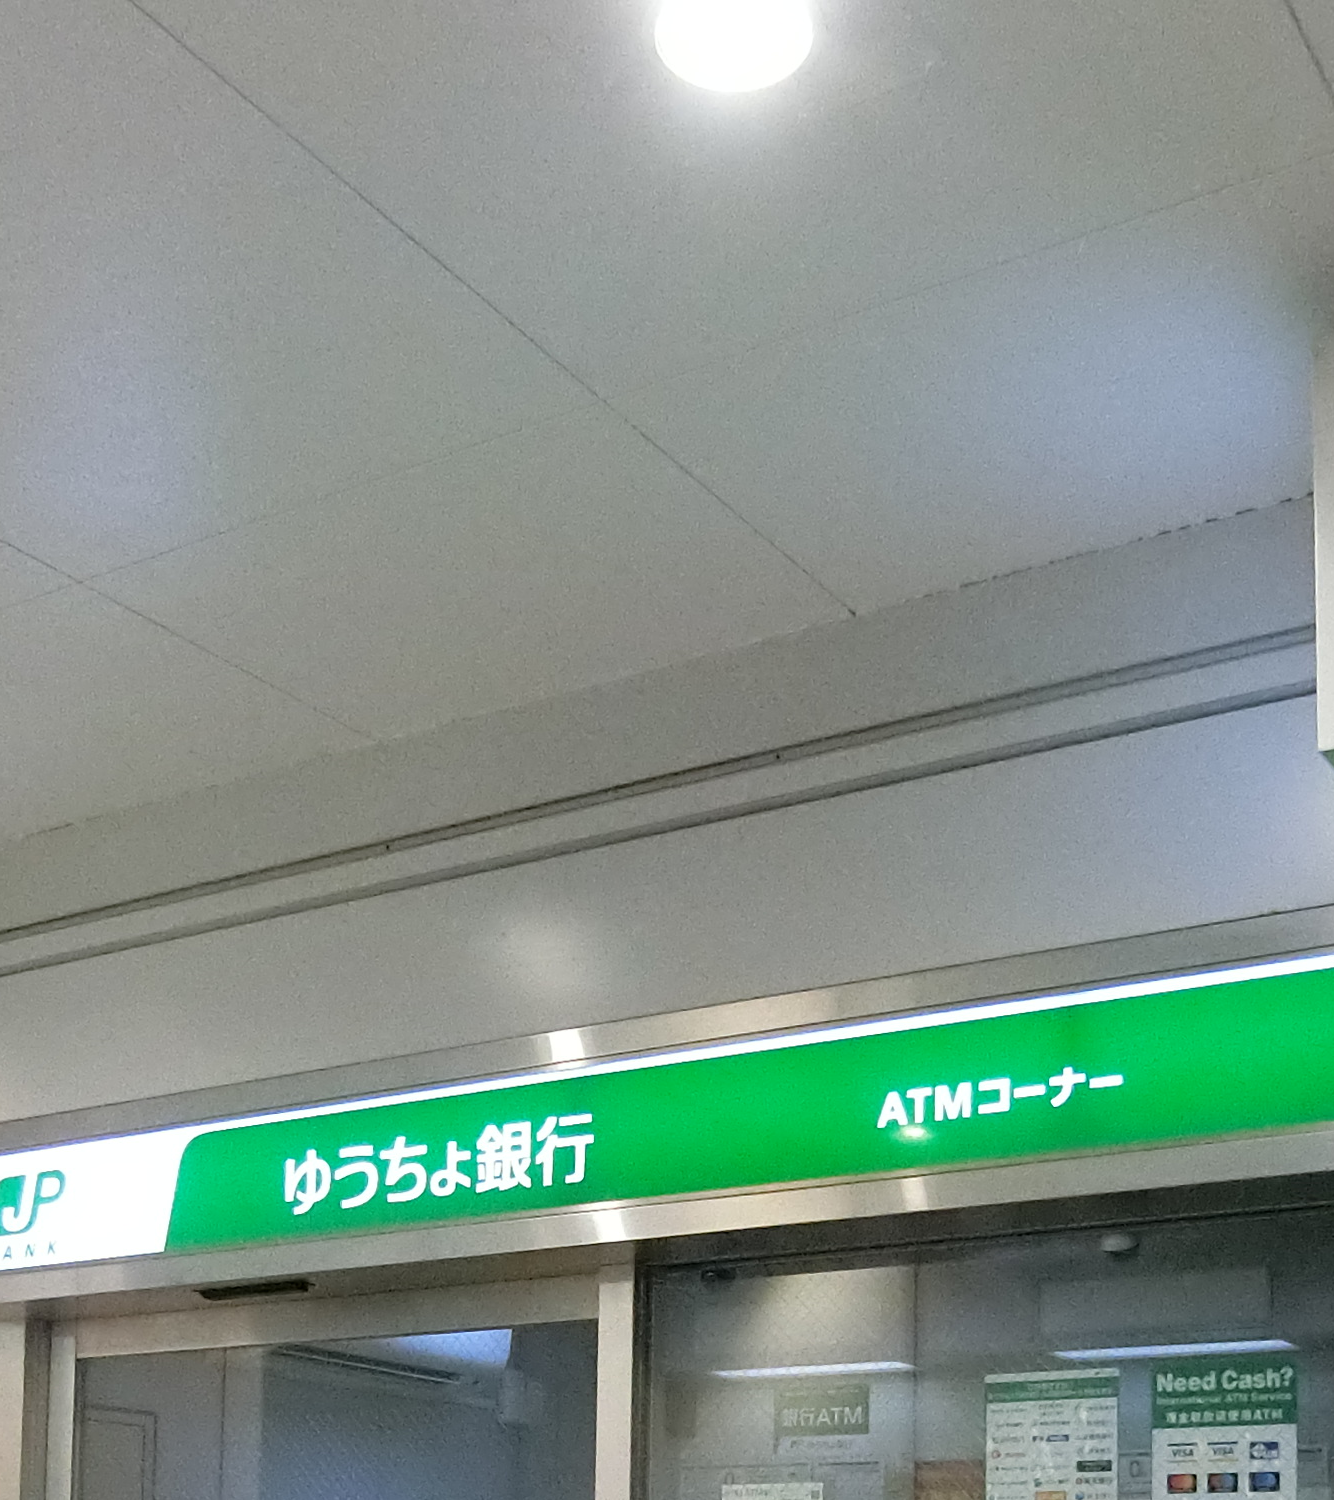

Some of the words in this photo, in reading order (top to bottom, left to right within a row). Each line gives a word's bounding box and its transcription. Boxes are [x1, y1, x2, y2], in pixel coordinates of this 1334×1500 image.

[877, 1067, 1124, 1128] ATMコーナー
[283, 1113, 595, 1215] ゆうちょ銀行
[1156, 1371, 1217, 1392] Need
[1221, 1366, 1294, 1391] Cash?
